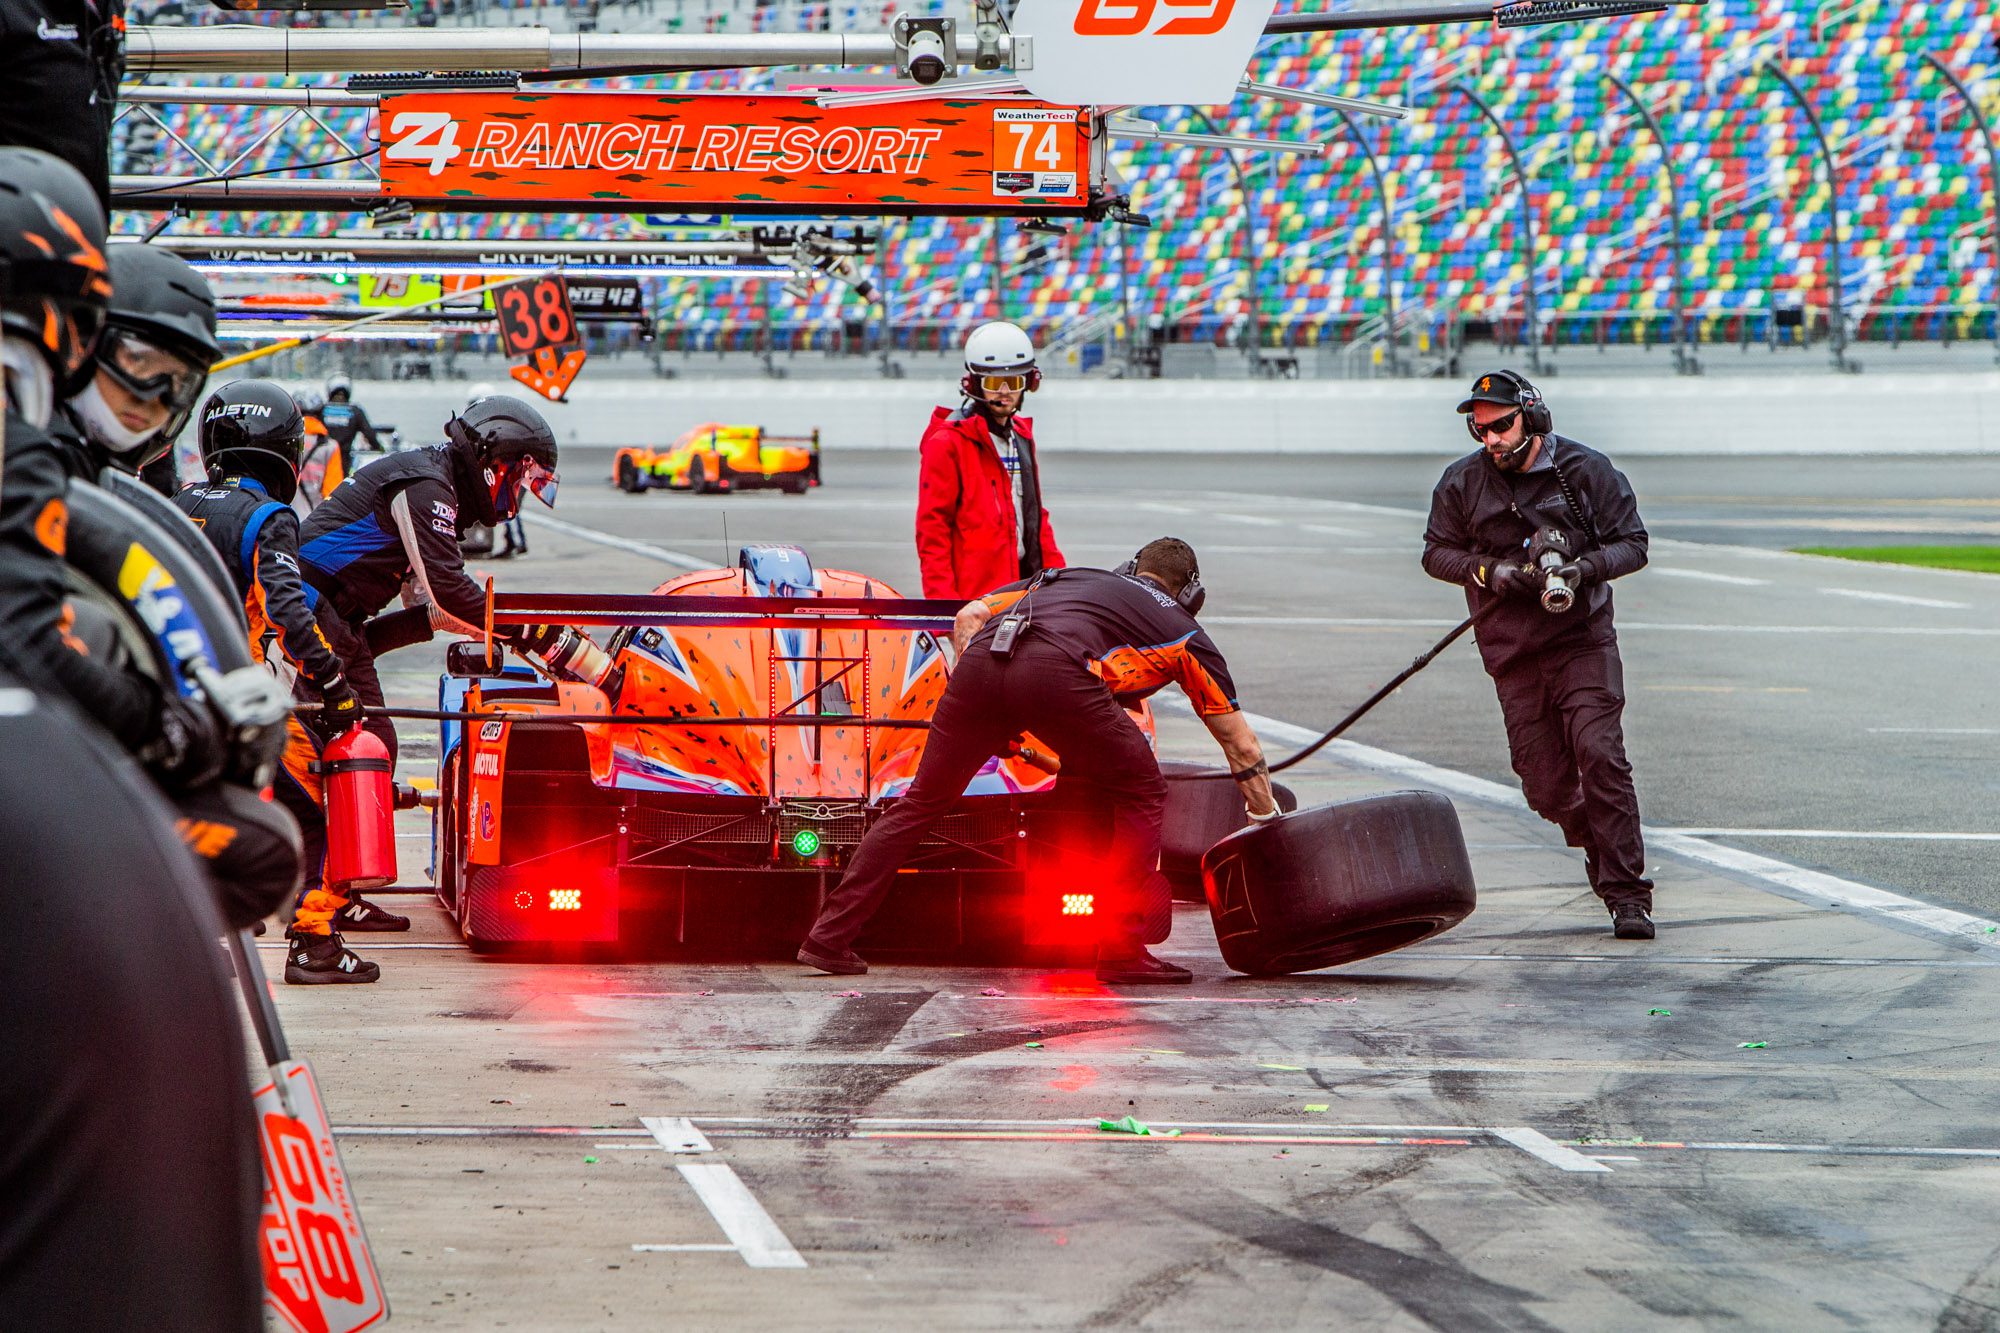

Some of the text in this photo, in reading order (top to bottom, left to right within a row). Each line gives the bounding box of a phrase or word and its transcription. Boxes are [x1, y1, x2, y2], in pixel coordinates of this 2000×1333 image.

[997, 112, 1075, 120] WeatherTech
[469, 121, 684, 171] RANCH
[691, 125, 942, 174] RESORT
[1009, 124, 1061, 170] 74
[607, 288, 638, 306] 42
[503, 280, 570, 349] 38
[206, 404, 272, 423] AUSTIN
[473, 752, 499, 777] MOTUL
